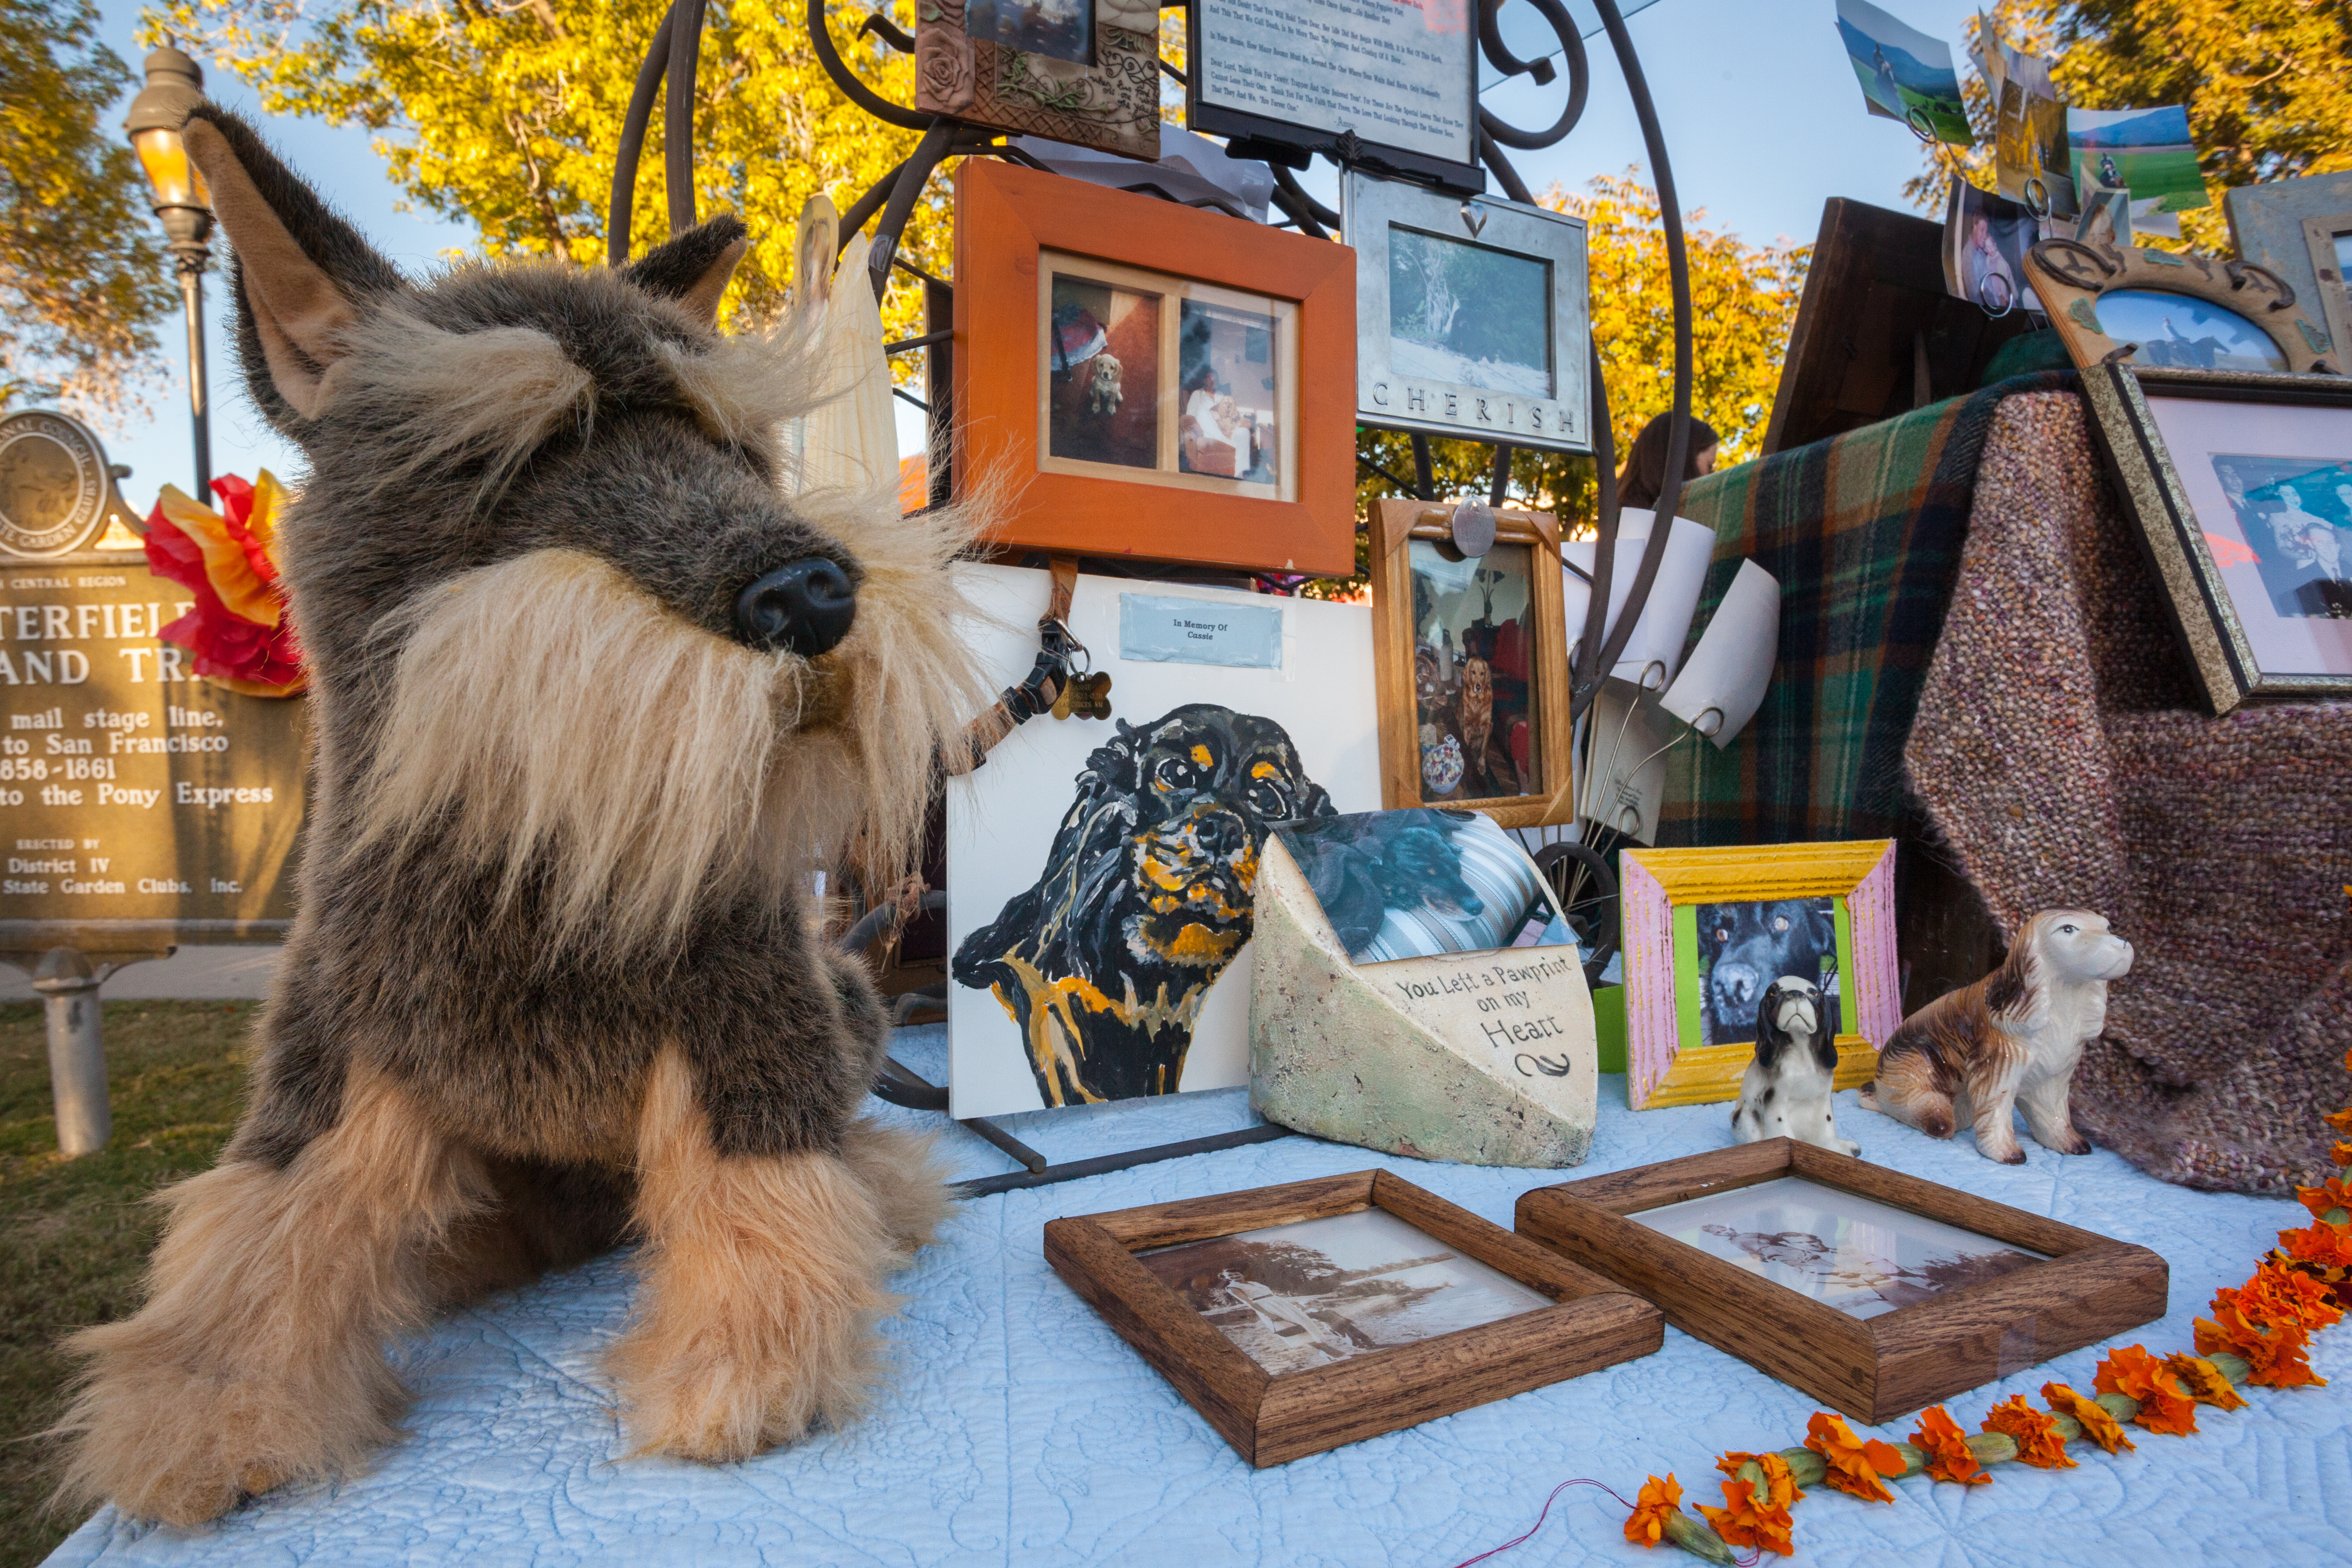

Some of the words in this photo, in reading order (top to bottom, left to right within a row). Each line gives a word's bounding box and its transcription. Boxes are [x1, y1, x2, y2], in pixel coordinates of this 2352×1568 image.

[1373, 383, 1574, 433] CHERISH
[77, 576, 127, 588] REGION
[1184, 620, 1216, 631] Memory
[1187, 631, 1213, 640] Cassie
[11, 707, 64, 729] mail
[84, 708, 150, 733] stage
[2, 735, 30, 755] to
[46, 733, 93, 755] San
[109, 732, 229, 754] Francisco
[0, 786, 24, 806] to
[40, 784, 83, 805] the
[97, 782, 161, 809] Pony
[176, 782, 274, 809] Express
[8, 857, 77, 874] District
[90, 857, 110, 873] IV
[3, 879, 49, 894] State
[60, 878, 126, 894] Garden
[1396, 981, 1439, 1000] You
[1438, 973, 1480, 993] Left
[1482, 973, 1495, 986] a
[1492, 955, 1573, 984] Pawprint
[1477, 996, 1500, 1012] on
[1506, 991, 1531, 1009] my
[1480, 1017, 1564, 1049] Heart
